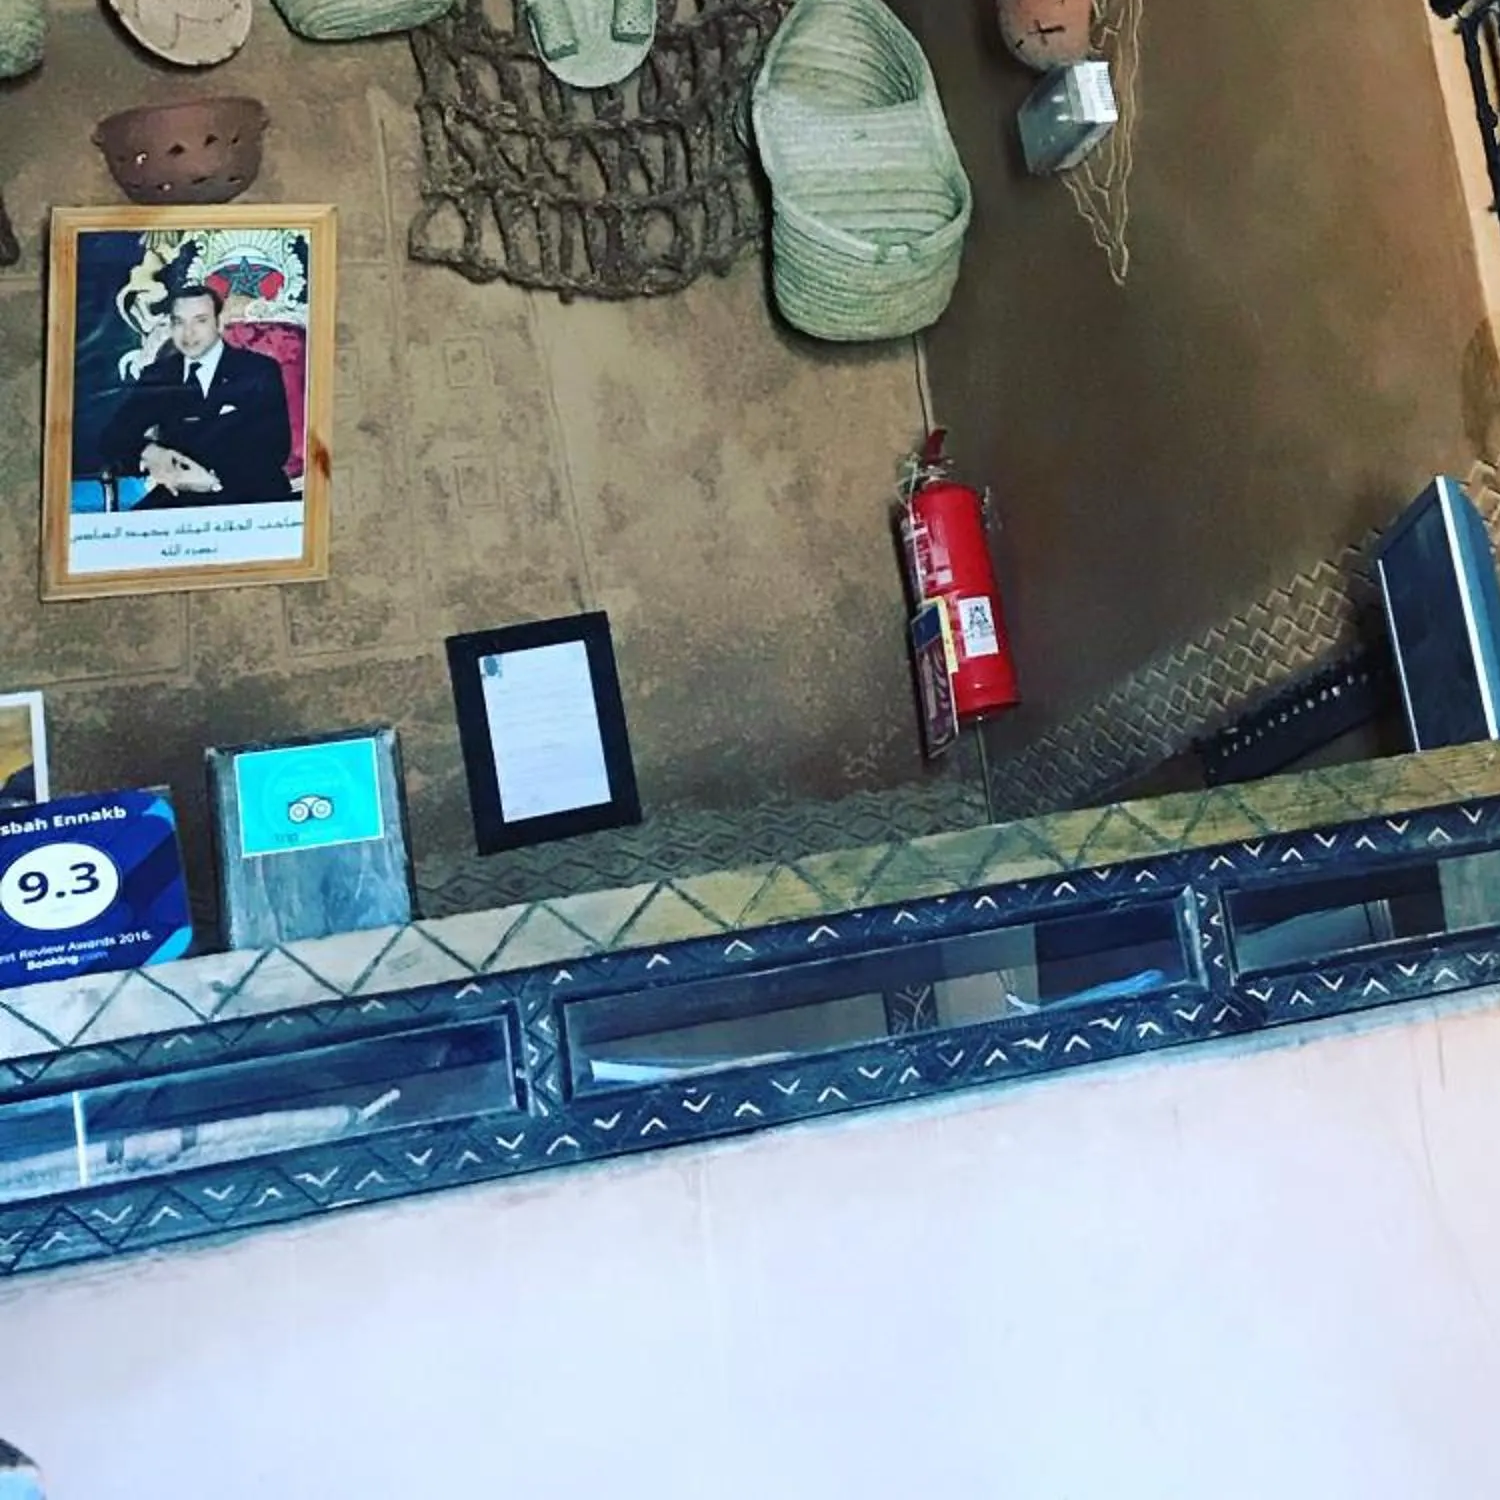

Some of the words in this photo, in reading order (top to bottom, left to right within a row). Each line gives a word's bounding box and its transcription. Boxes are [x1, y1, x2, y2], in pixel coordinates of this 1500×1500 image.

[53, 806, 126, 828] Ennakb
[18, 862, 99, 904] 9.3
[119, 930, 151, 944] 2016
